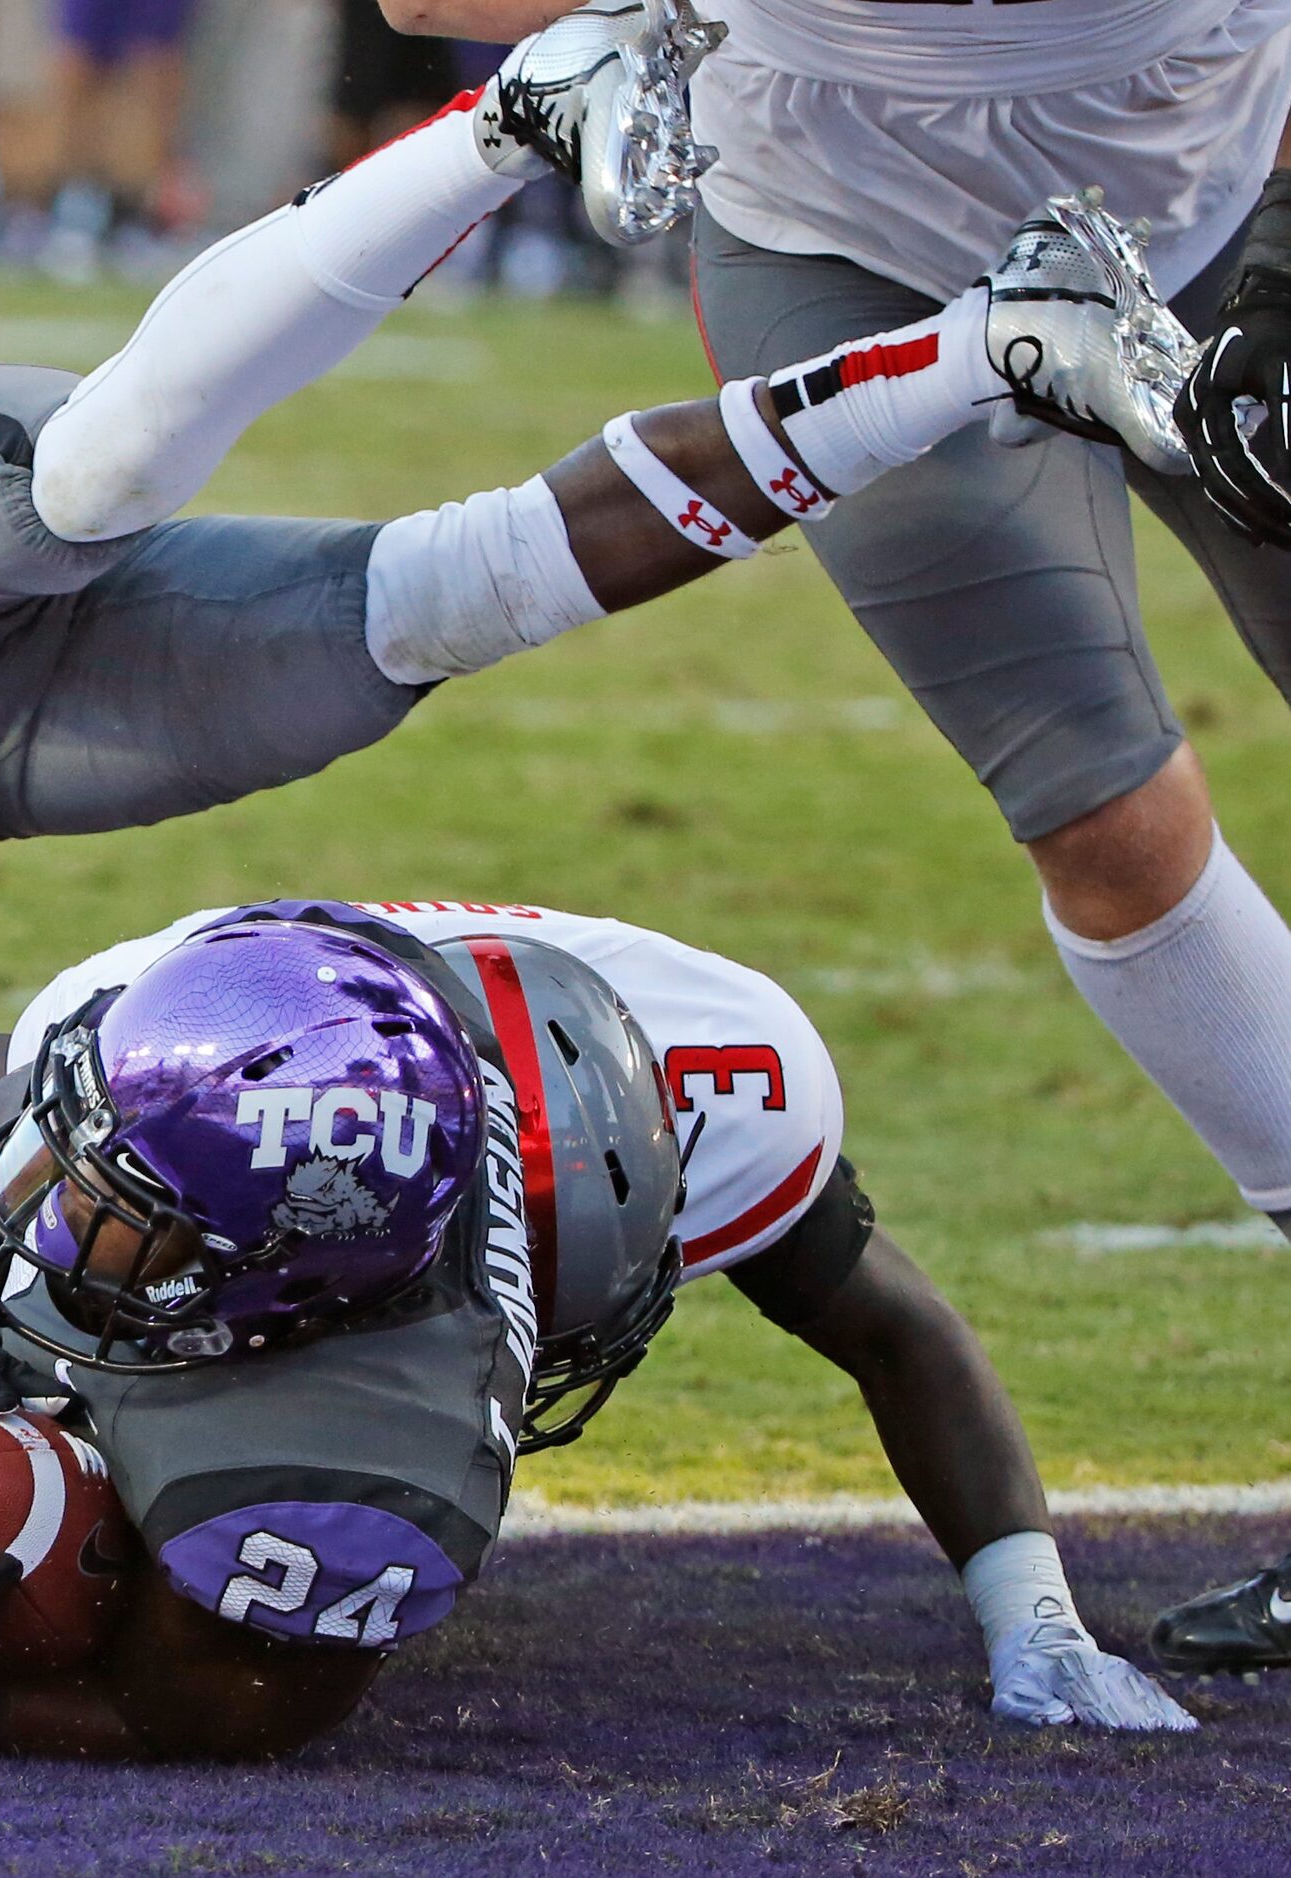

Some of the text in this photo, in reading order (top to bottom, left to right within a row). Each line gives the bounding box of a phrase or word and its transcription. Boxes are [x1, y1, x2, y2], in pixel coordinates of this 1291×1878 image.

[75, 1051, 101, 1112] FROGS
[665, 1044, 786, 1112] 3
[236, 1086, 438, 1179] TCU
[215, 1528, 417, 1650] 24
